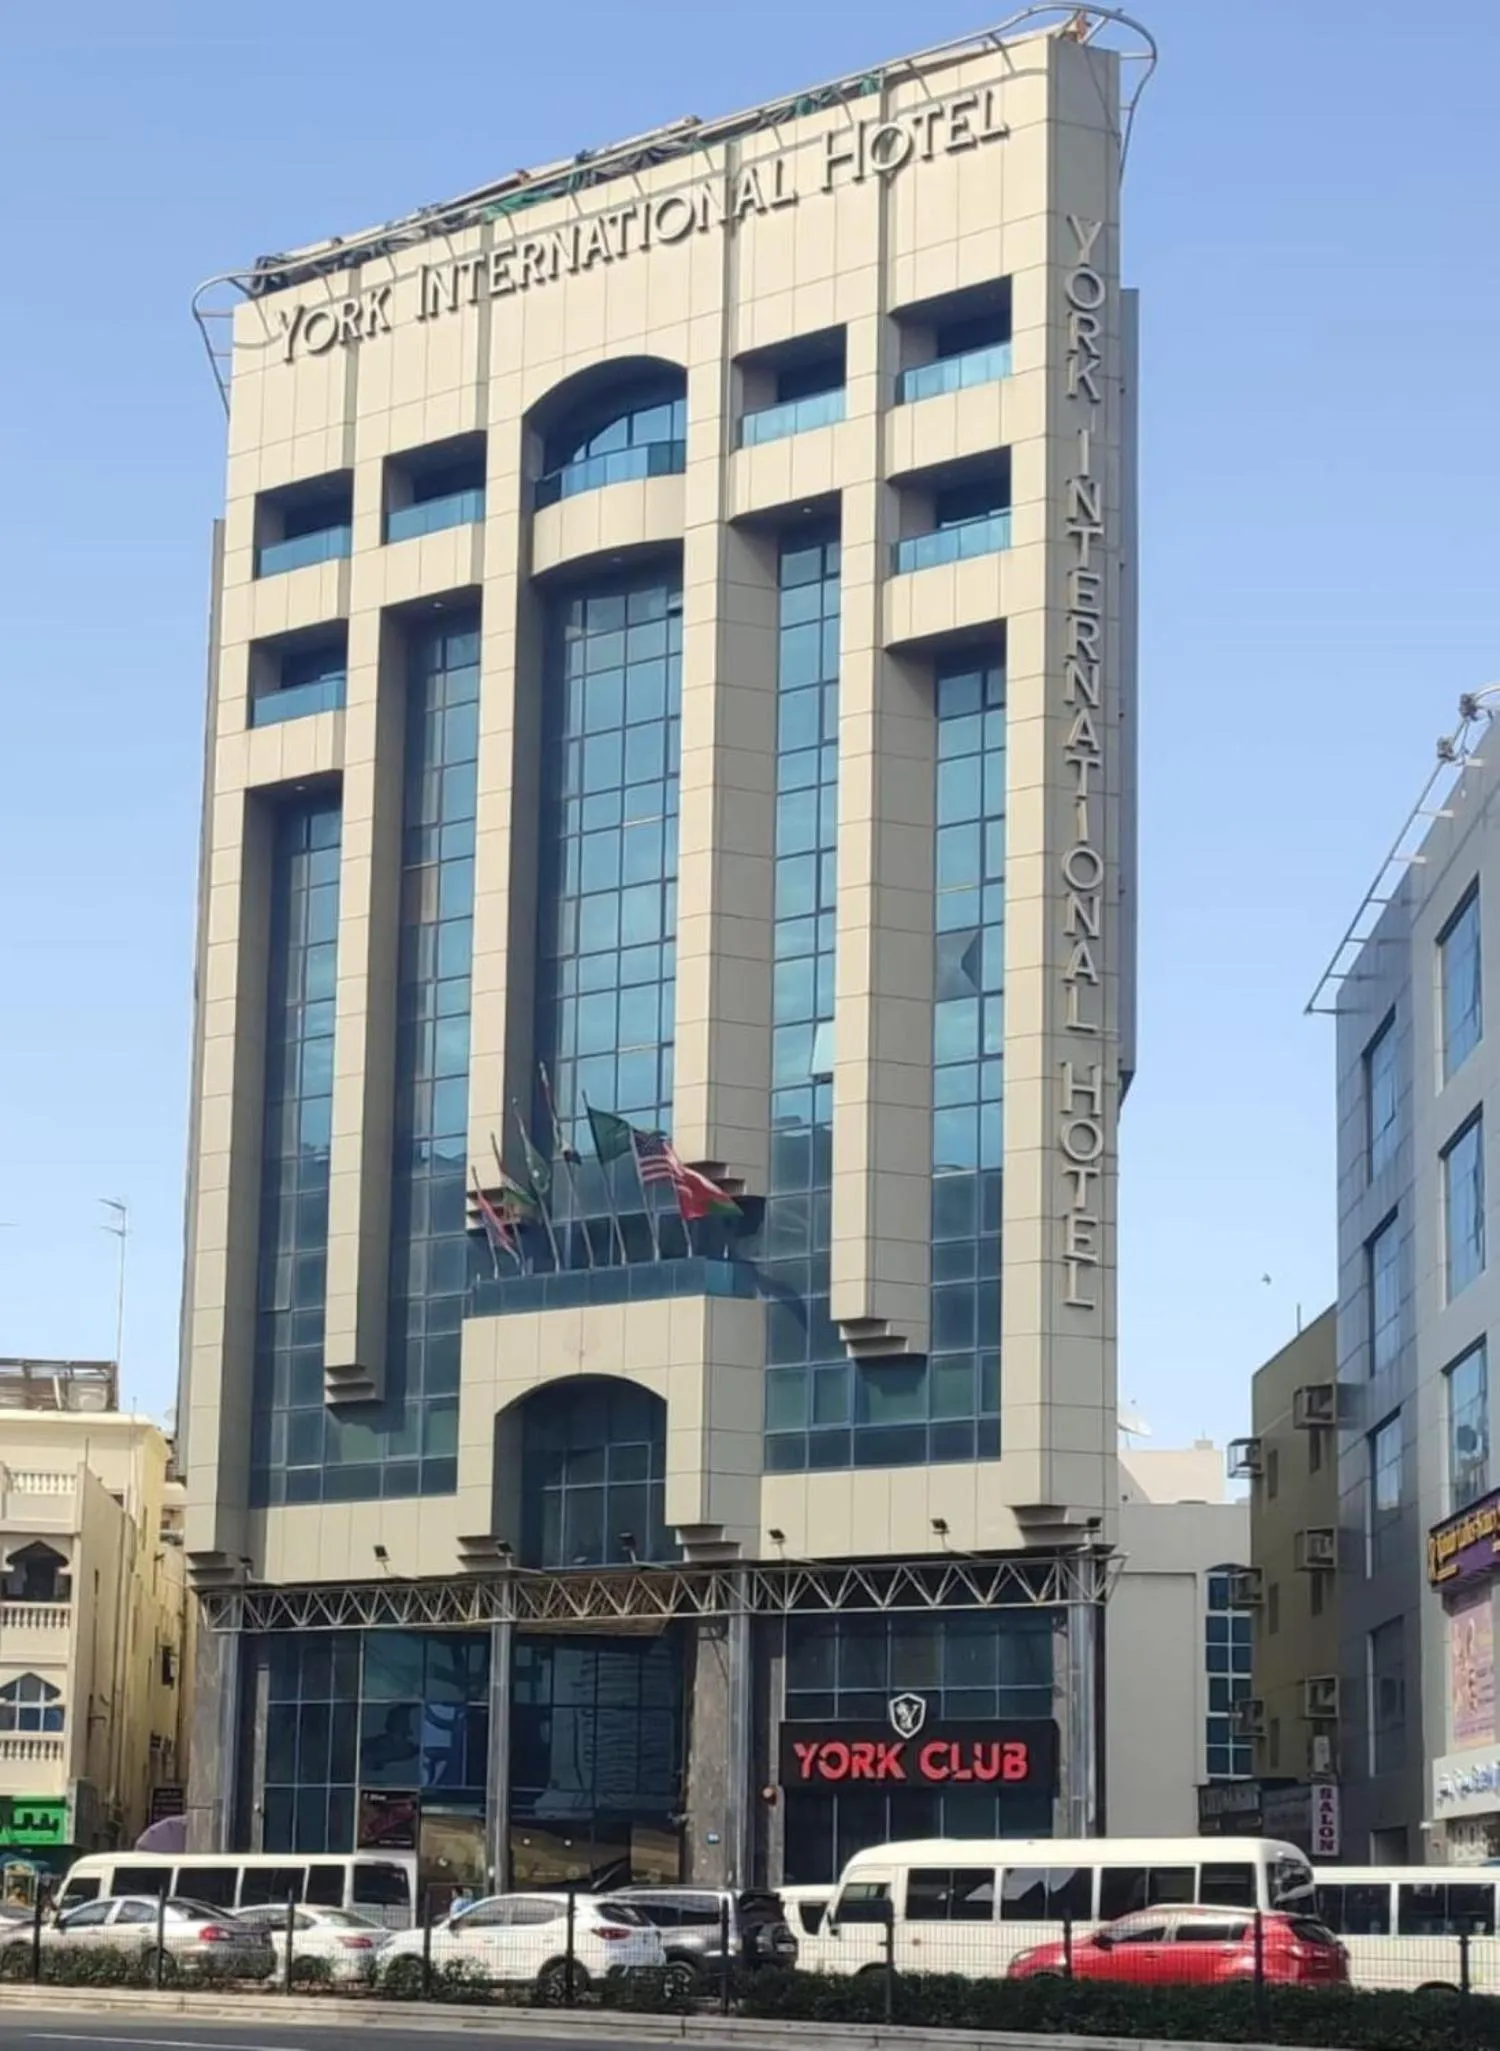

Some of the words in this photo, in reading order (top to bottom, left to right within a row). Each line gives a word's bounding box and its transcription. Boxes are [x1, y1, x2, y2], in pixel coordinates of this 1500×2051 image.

[280, 288, 393, 364] YORK
[415, 158, 798, 322] INTERNATIONAL
[821, 88, 1010, 193] HOTEL
[1064, 214, 1106, 401] YORK
[1062, 428, 1104, 1034] INTERNATIONAL
[1061, 1061, 1103, 1307] HOTEL
[793, 1741, 907, 1781] YORK
[919, 1740, 1029, 1781] CLUB
[1318, 1787, 1335, 1852] SALON
